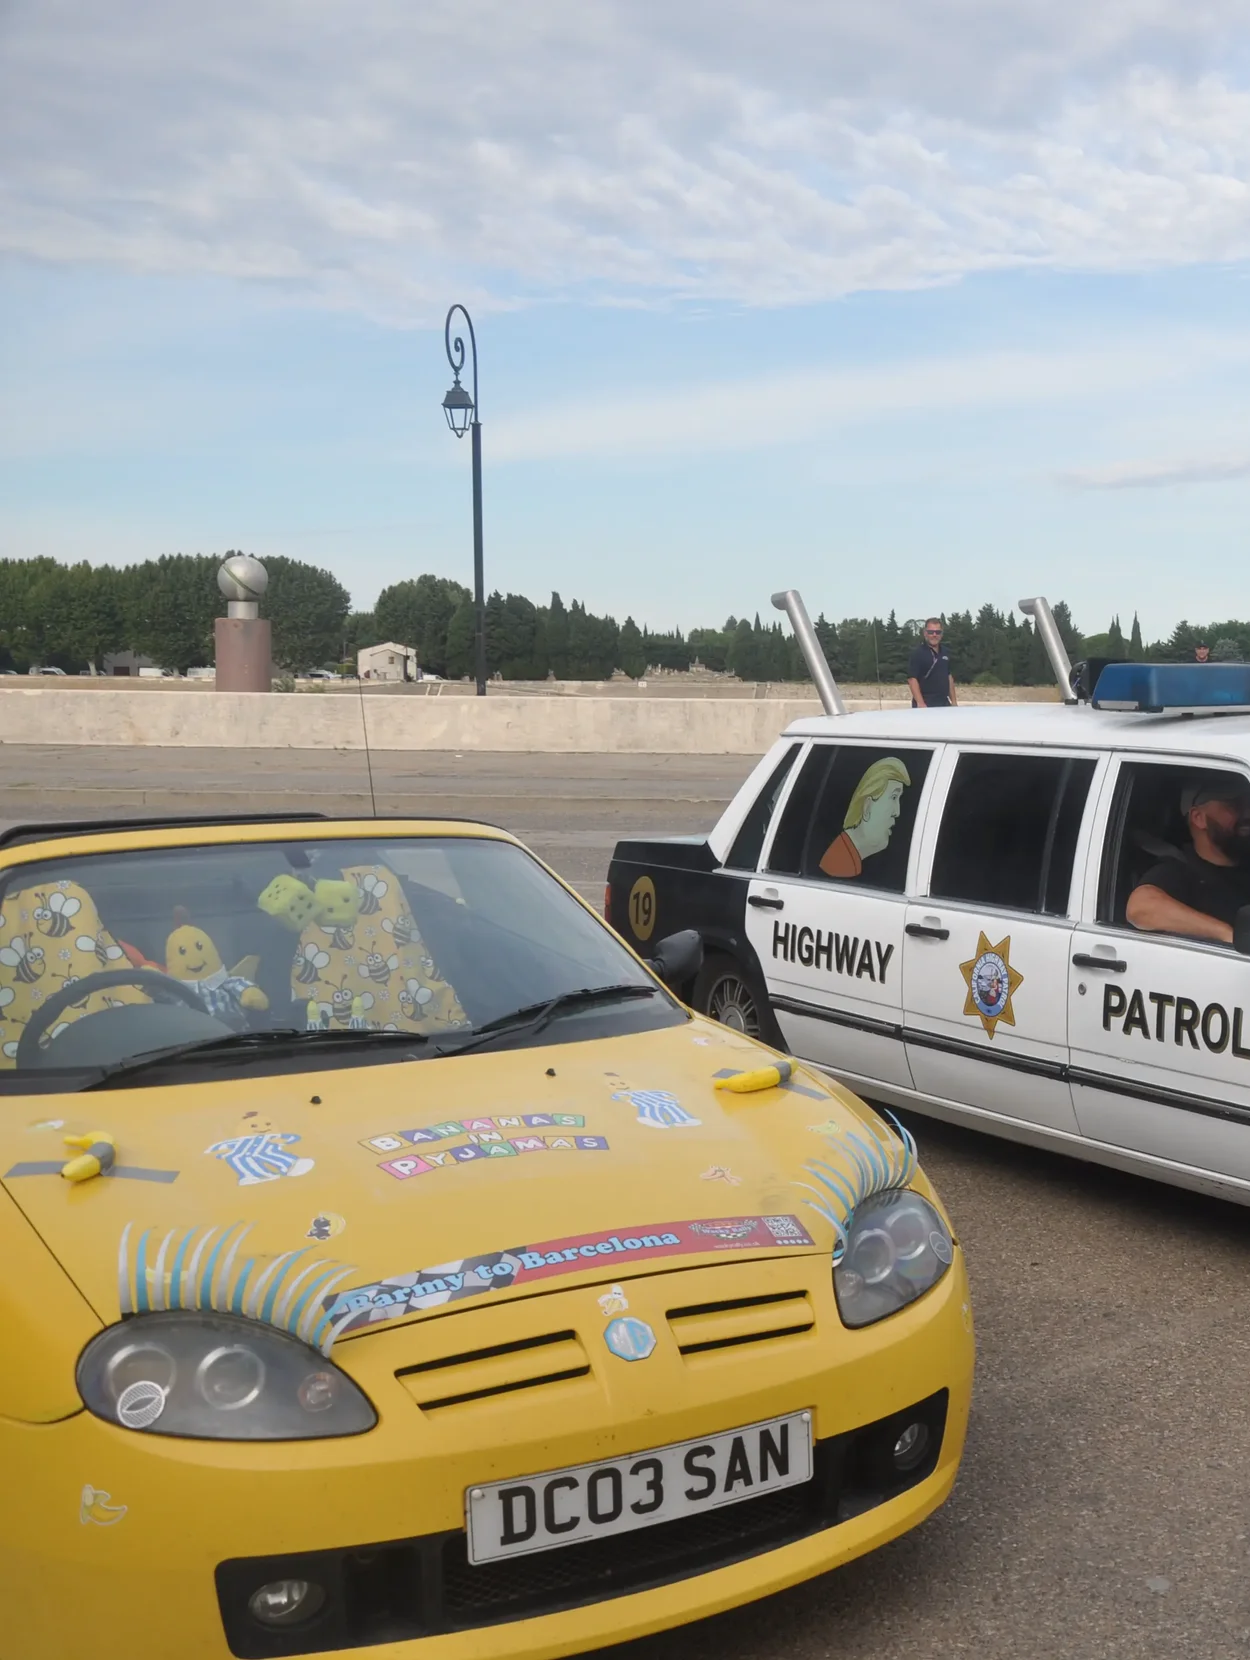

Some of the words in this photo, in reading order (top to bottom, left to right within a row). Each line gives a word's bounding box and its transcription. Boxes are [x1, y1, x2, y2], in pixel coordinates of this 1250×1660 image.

[632, 891, 652, 927] 19
[773, 920, 895, 984] HIGHWAY
[368, 1115, 578, 1151] BANANAS
[468, 1131, 503, 1144] IN
[390, 1137, 599, 1175] PYJAMAS
[346, 1272, 465, 1312] Barmy
[474, 1261, 515, 1280] to
[520, 1230, 682, 1271] Barcelona
[683, 1423, 790, 1501] SAN
